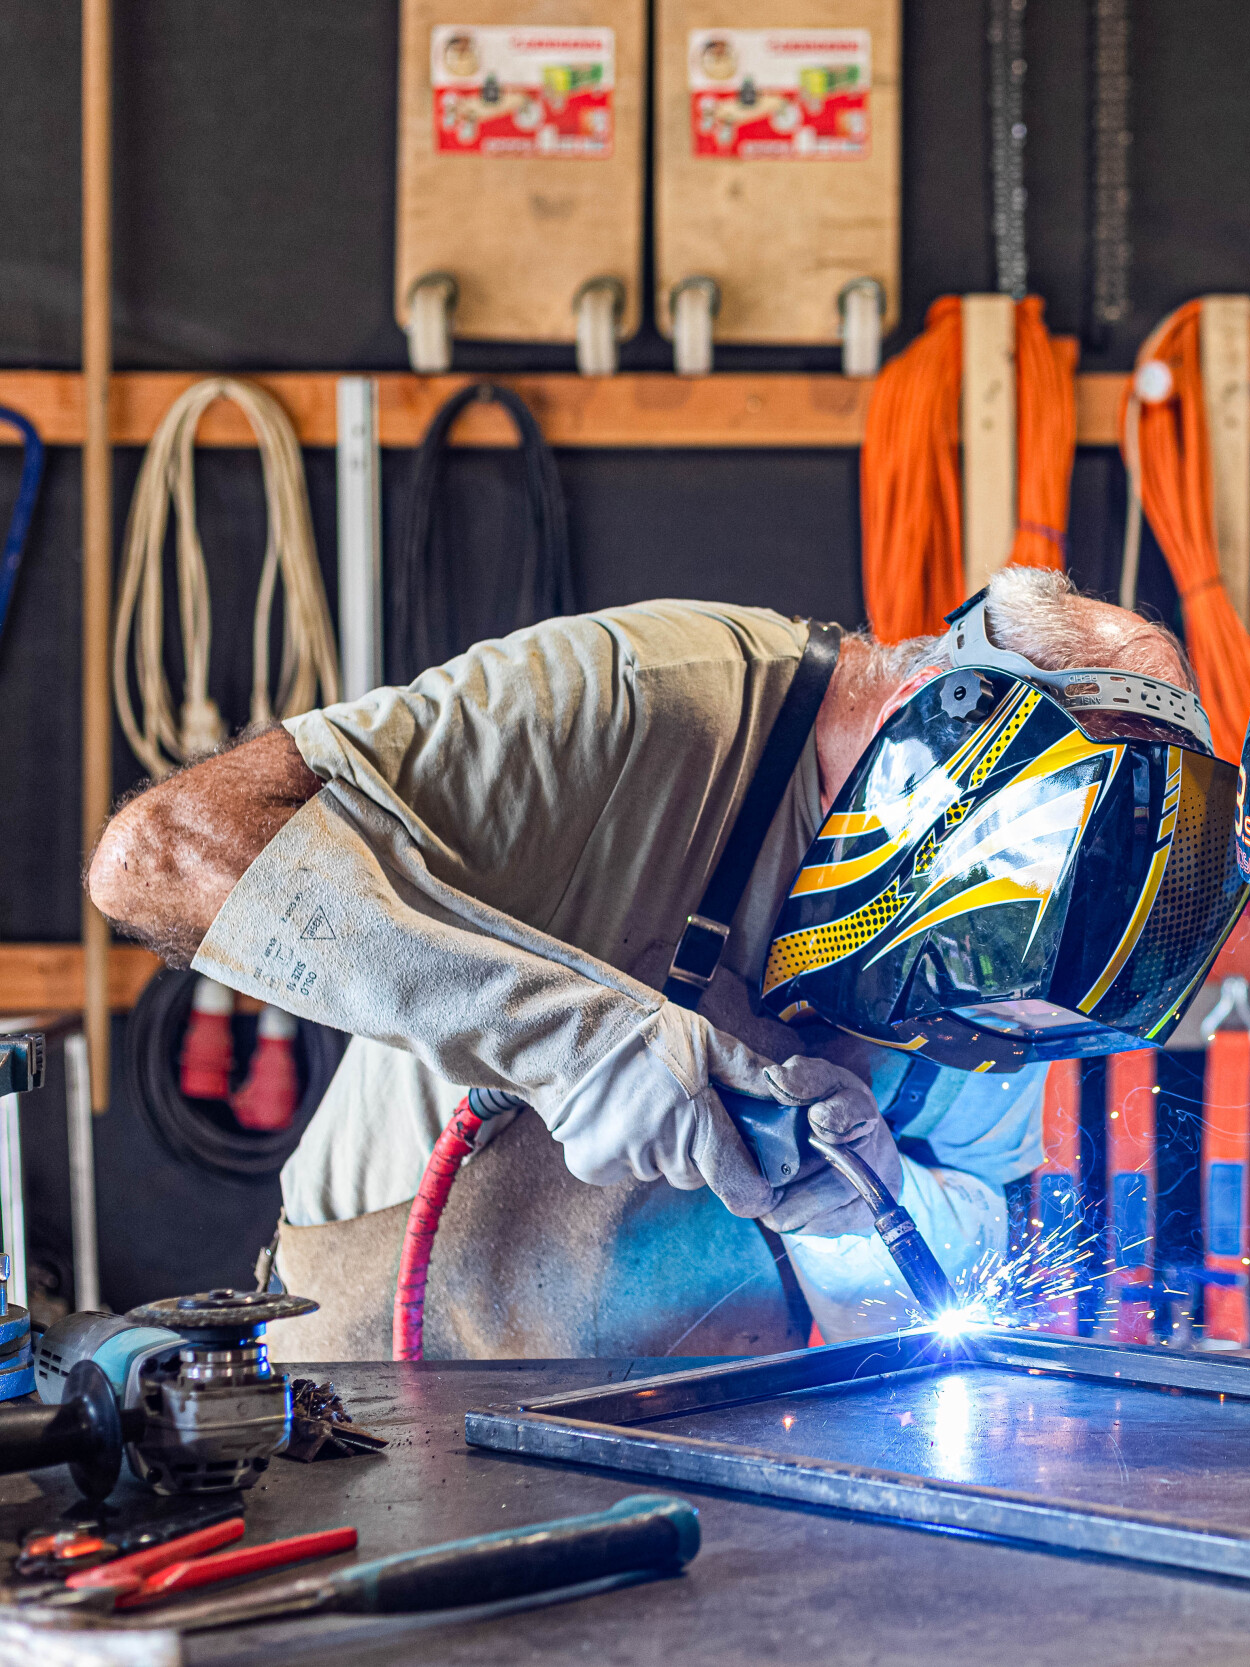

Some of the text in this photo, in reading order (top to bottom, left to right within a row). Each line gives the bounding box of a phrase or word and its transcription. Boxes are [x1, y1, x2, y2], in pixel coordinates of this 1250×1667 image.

[306, 914, 324, 938] Hase
[291, 961, 306, 981] SIZE
[300, 971, 317, 996] OSLO
